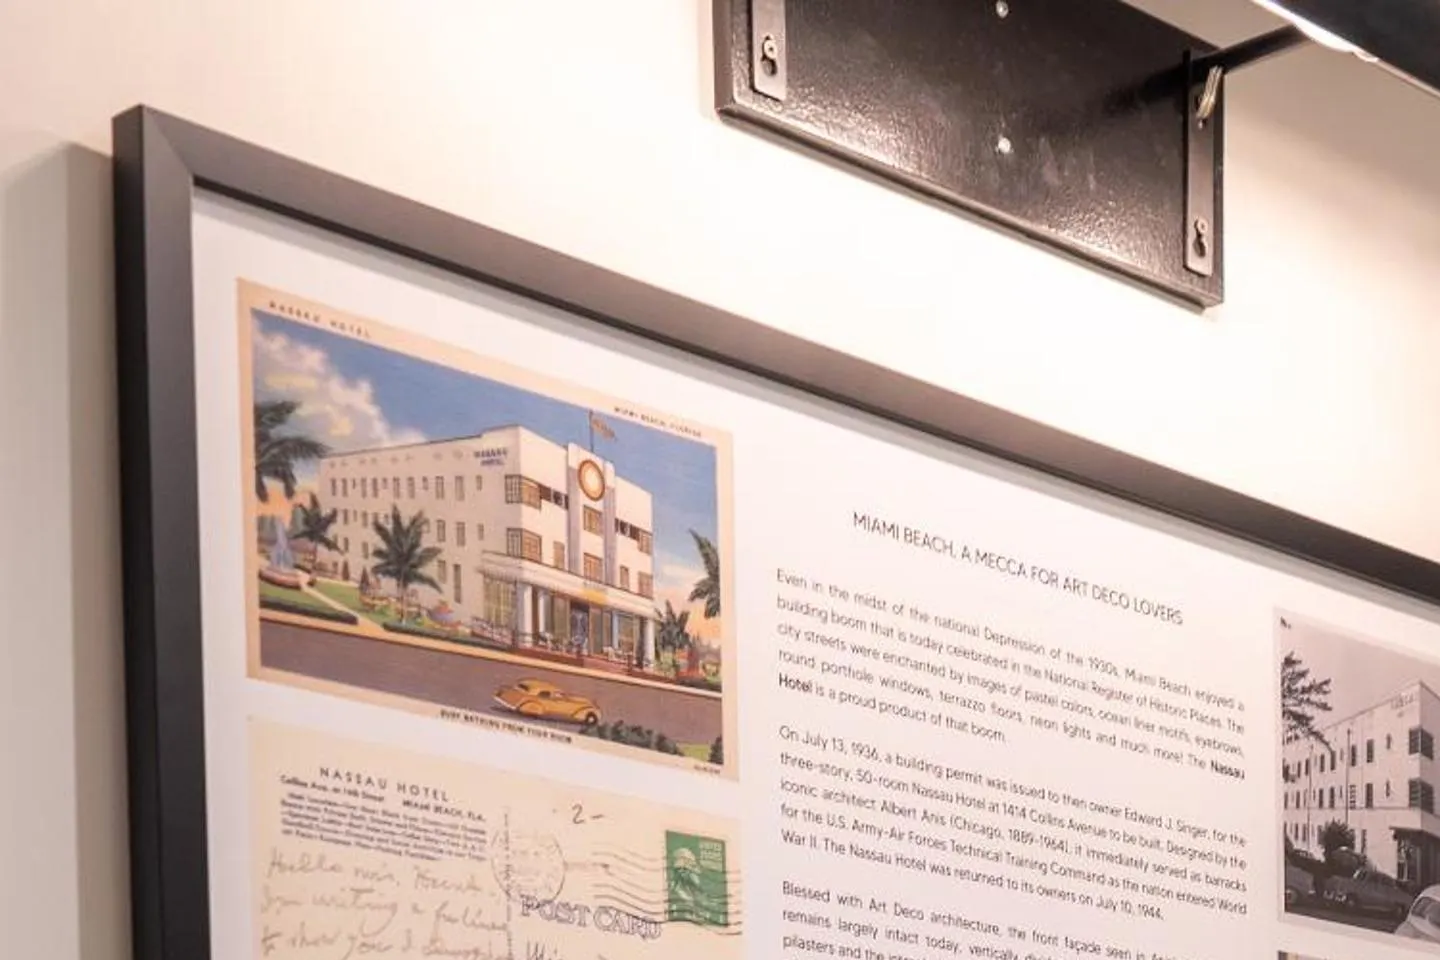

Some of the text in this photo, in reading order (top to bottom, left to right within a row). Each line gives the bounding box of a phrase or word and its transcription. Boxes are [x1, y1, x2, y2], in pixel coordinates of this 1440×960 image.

[852, 509, 900, 541] MIAMI
[960, 542, 971, 562] A
[974, 546, 1027, 579] MECCA
[1030, 563, 1059, 588] FOR
[1062, 573, 1088, 597] ART
[1091, 581, 1130, 609] DECO
[1132, 594, 1183, 625] LOVERS
[777, 670, 813, 695] Hotel
[815, 681, 825, 698] is
[828, 687, 835, 701] a
[838, 690, 876, 711] proud
[879, 700, 927, 723] product
[929, 710, 942, 727] of
[945, 713, 968, 734] that
[319, 767, 449, 801] NASSAU HOTEL
[778, 723, 983, 787] On July 13, 1936, a building permit
[1187, 751, 1245, 780] The Nassau
[780, 827, 806, 848] War
[822, 836, 846, 856] The
[849, 841, 891, 866] Nassau
[894, 851, 926, 873] Hotel
[929, 862, 951, 878] was
[954, 866, 1004, 889] returned
[1006, 874, 1018, 892] to
[1020, 878, 1034, 895] its
[1036, 884, 1076, 903] owners
[1078, 893, 1093, 907] on
[1096, 893, 1118, 916] July
[520, 894, 662, 940] POST CARD
